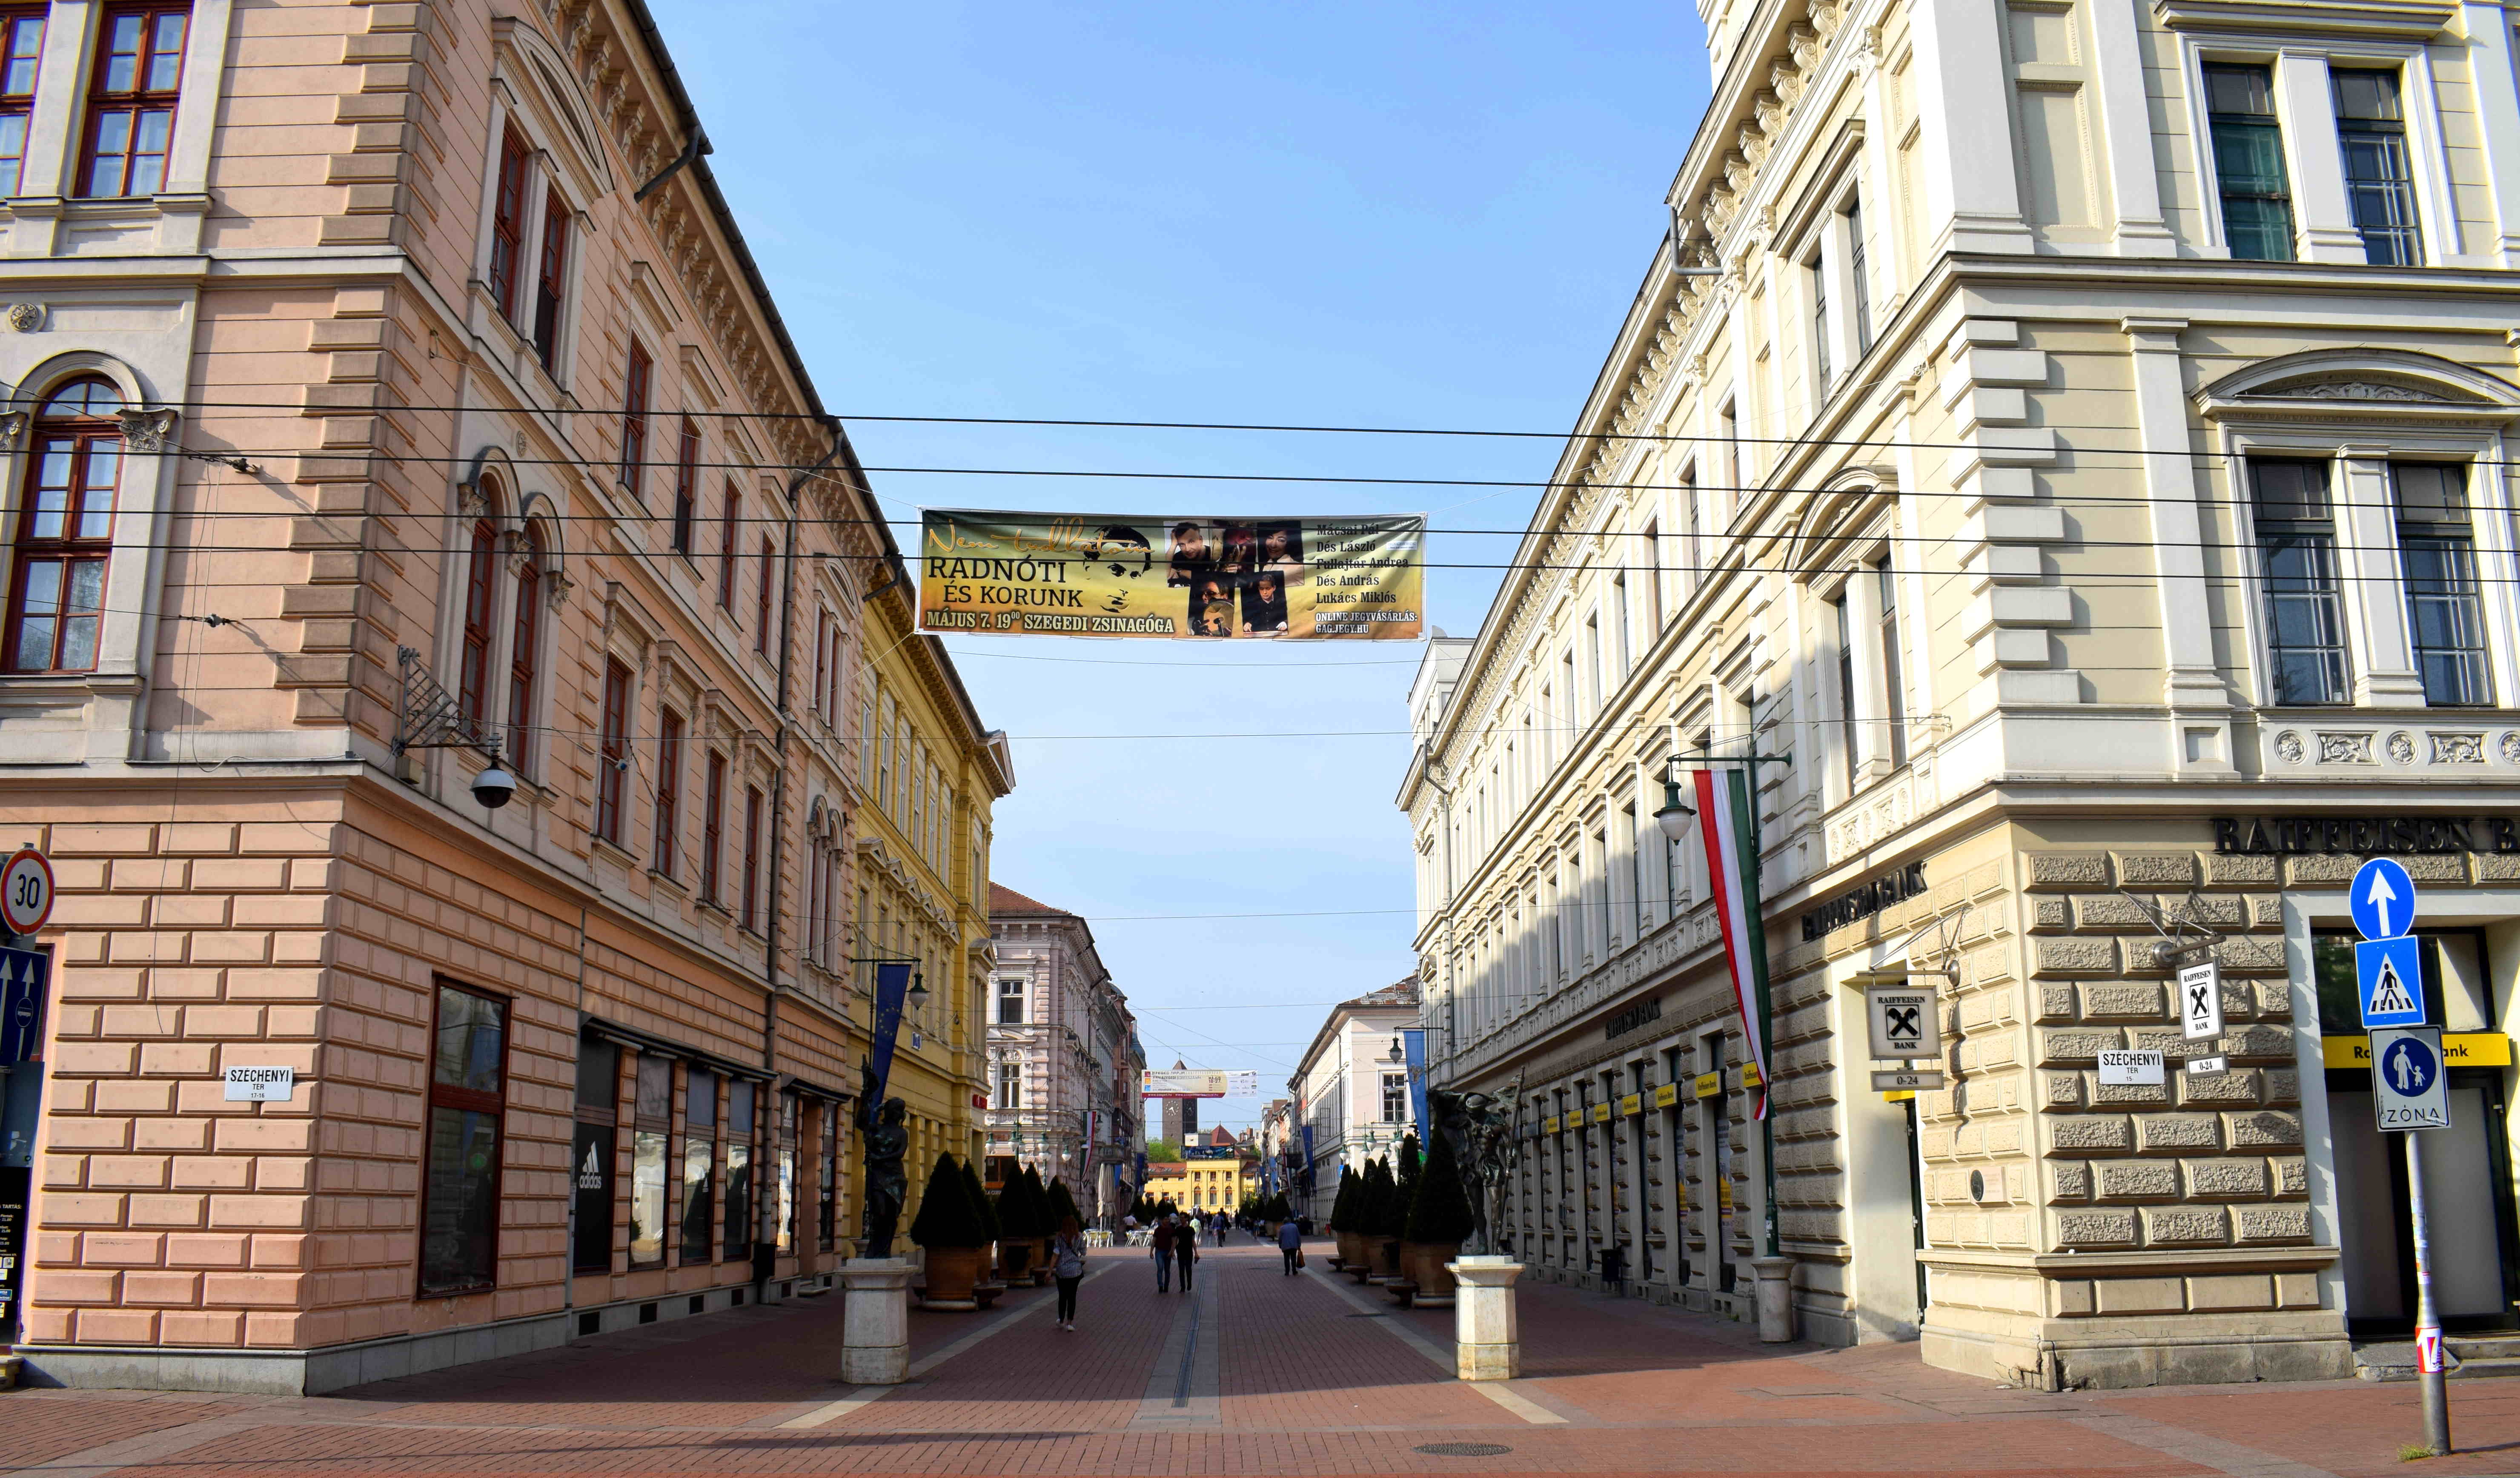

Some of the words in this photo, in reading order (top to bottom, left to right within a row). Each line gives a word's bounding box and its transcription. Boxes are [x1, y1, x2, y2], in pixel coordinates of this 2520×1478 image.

[929, 519, 999, 552] Nem
[991, 516, 1155, 553] tudhatom
[1317, 523, 1357, 536] Mácsai
[1361, 524, 1379, 534] Pál
[1317, 540, 1336, 552] Dés
[1340, 540, 1376, 552] László
[928, 554, 1066, 583] RADNÓTI
[1369, 557, 1409, 568] Andrea
[1316, 575, 1336, 586] Dés
[1339, 574, 1380, 586] András
[943, 580, 972, 603] ÉS
[980, 586, 1083, 607] KORUNK
[1316, 592, 1357, 604] Lukács
[1360, 591, 1397, 603] Miklós
[926, 607, 976, 628] MÁJUS
[980, 613, 991, 628] 7.
[1024, 614, 1088, 631] SZEGEDI
[1092, 614, 1174, 633] ZSINAGÓGA
[1315, 612, 1348, 622] ONLINE
[1350, 610, 1418, 622] JEGYVÁSÁRLÁS:
[1315, 624, 1369, 633] GAG.JEGY.HU
[2214, 817, 2473, 851] RAIFFEISEN
[15, 874, 40, 909] 30
[1876, 860, 1927, 911] BANK
[2184, 970, 2211, 982] RAIFFEISEN
[2195, 1022, 2208, 1031] BANK
[2444, 1044, 2469, 1057] ank
[2103, 1051, 2160, 1066] SZÉCHENYI
[2199, 1061, 2213, 1070] 0-24
[230, 1068, 289, 1082] SZÉCHENYI
[1897, 1076, 1919, 1085] 0-24
[2387, 1105, 2440, 1122] ZÓNA
[579, 1172, 601, 1189] adidas
